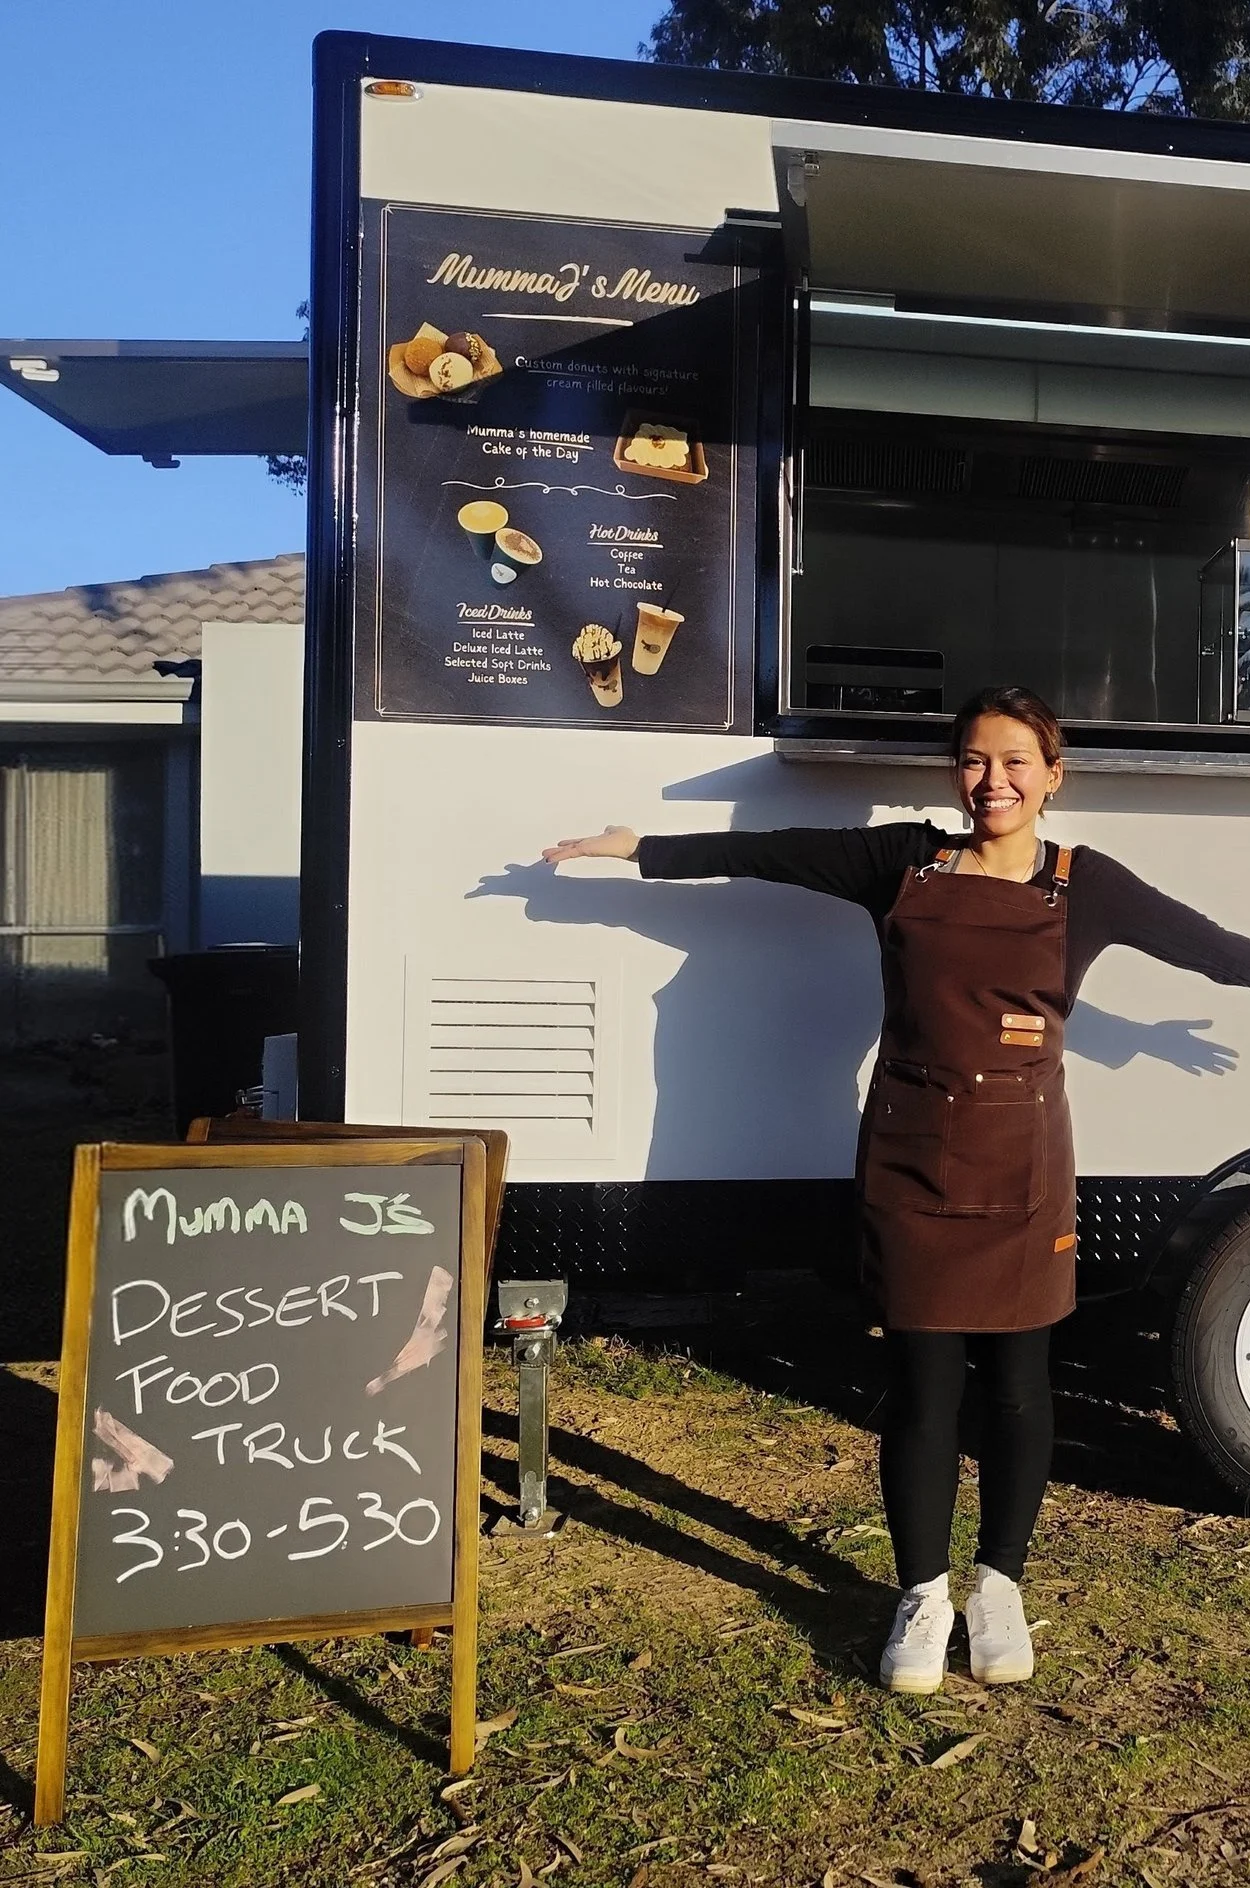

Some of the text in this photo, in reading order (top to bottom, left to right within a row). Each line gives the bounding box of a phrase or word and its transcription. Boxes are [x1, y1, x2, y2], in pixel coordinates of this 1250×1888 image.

[607, 267, 700, 305] Menu
[515, 355, 700, 381] Custom donuts with signature
[546, 379, 582, 389] cream
[587, 379, 614, 392] filled
[466, 424, 590, 443] Mumma's homemade
[482, 442, 579, 463] Cake of the Day
[589, 523, 659, 541] Hot Drinks
[610, 548, 644, 562] Coffee
[617, 563, 636, 574] Tea
[590, 577, 663, 590] Hot Chocolate
[456, 602, 533, 620] Iced Drinks
[472, 628, 525, 640] Iced Latte
[453, 641, 544, 656] Deluxe Iced Latte
[444, 656, 552, 672] Selected Soft Drinks
[467, 672, 528, 685] Juice Boxes
[112, 1271, 404, 1346] DESSERT
[115, 1355, 280, 1414] FOOD
[191, 1420, 421, 1475] TRUCK
